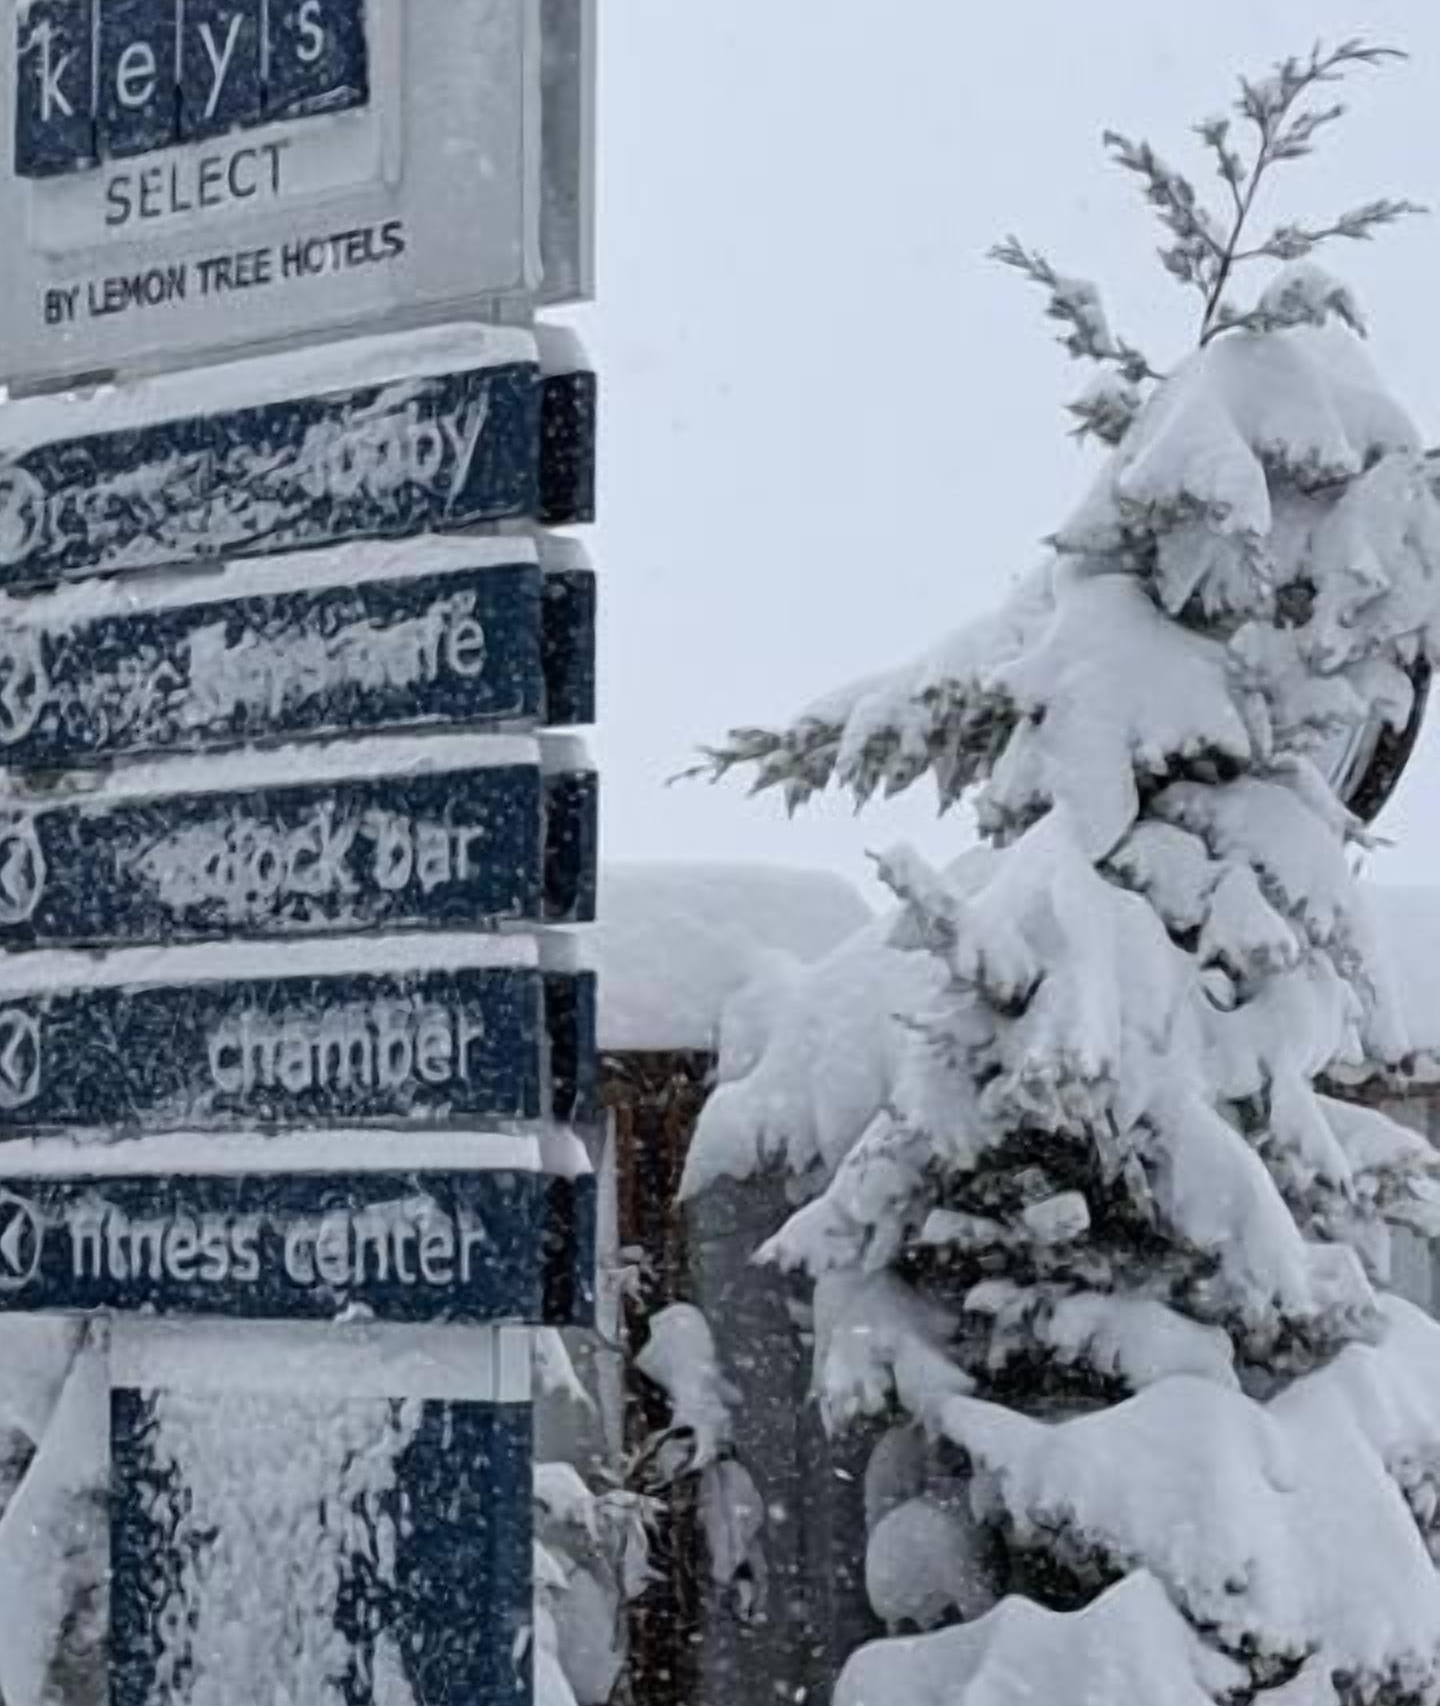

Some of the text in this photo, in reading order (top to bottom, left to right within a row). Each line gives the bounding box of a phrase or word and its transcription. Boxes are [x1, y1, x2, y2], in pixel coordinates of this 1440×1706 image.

[105, 139, 291, 225] SELECT
[44, 221, 407, 324] BY LEMON TREE HOTELS
[374, 811, 483, 893] bar
[209, 1005, 483, 1093] chamber
[67, 1195, 484, 1286] fitness center
